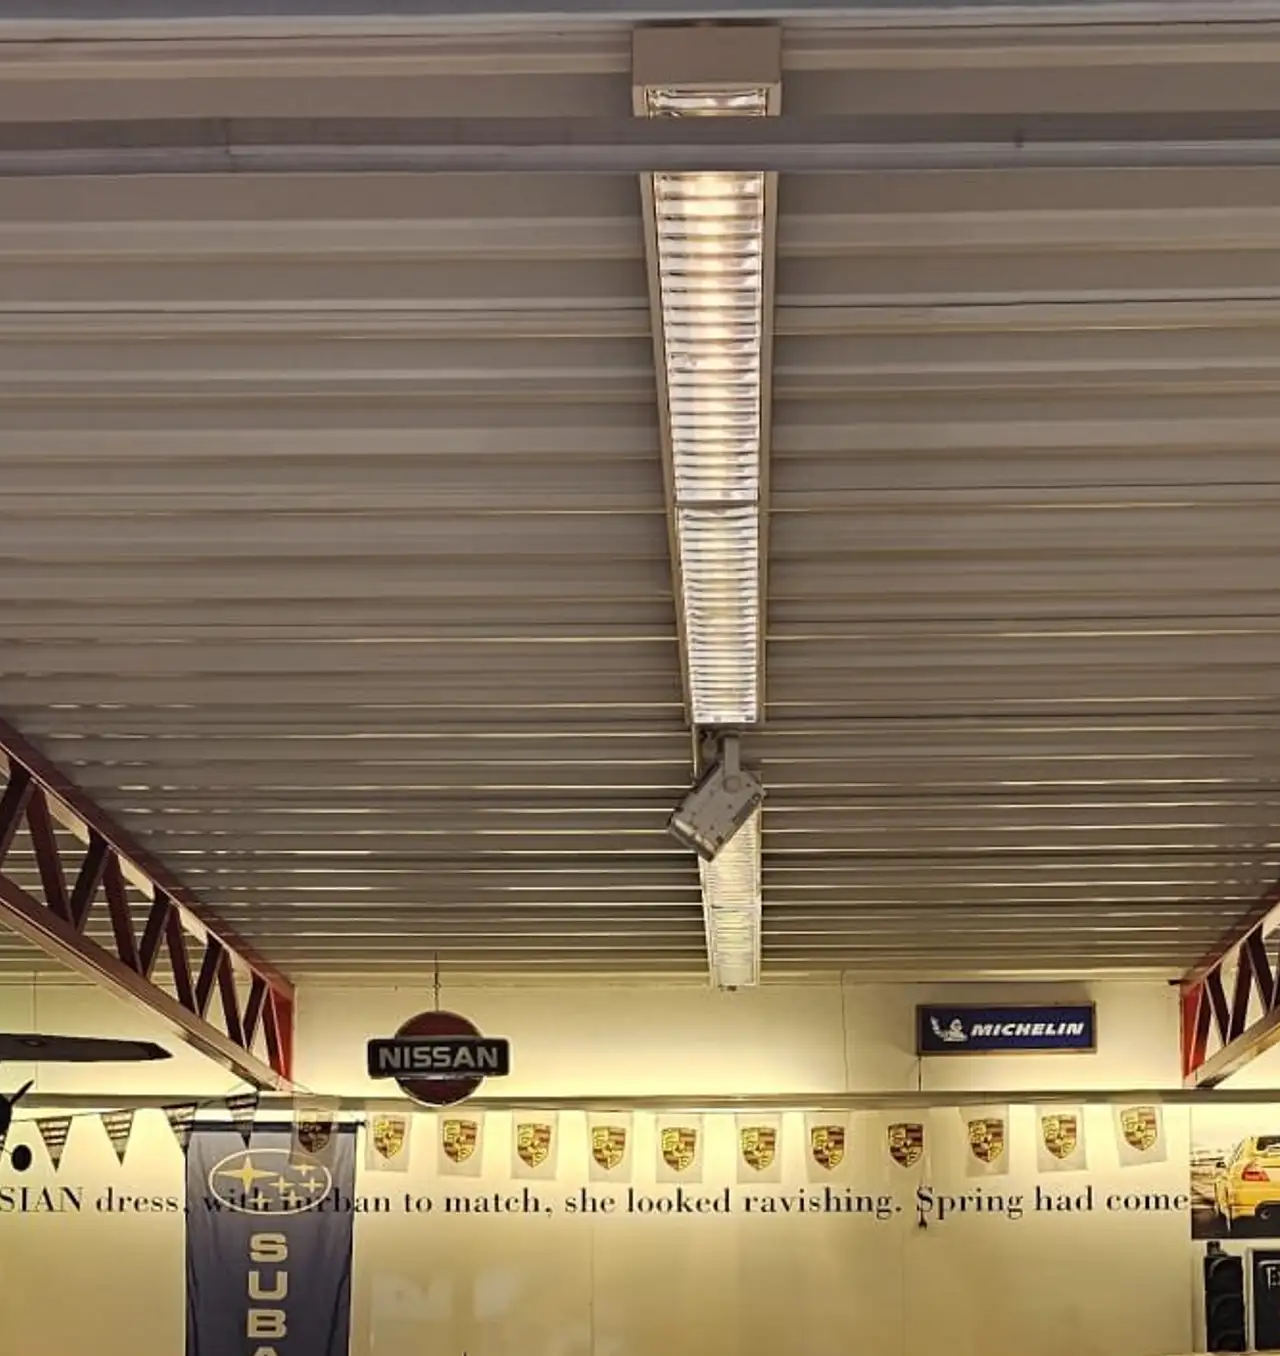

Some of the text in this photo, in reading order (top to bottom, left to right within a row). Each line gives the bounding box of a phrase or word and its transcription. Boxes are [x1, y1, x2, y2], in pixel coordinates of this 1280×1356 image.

[971, 1022, 1084, 1036] MICHELIN
[379, 1046, 498, 1068] NISSAN
[96, 1187, 189, 1215] dress,
[404, 1192, 432, 1213] to
[444, 1187, 553, 1217] match,
[564, 1187, 615, 1213] she
[627, 1187, 731, 1213] looked
[744, 1187, 902, 1220] ravishing.
[916, 1186, 1024, 1220] Spring
[1035, 1186, 1093, 1211] had
[1106, 1191, 1189, 1211] come
